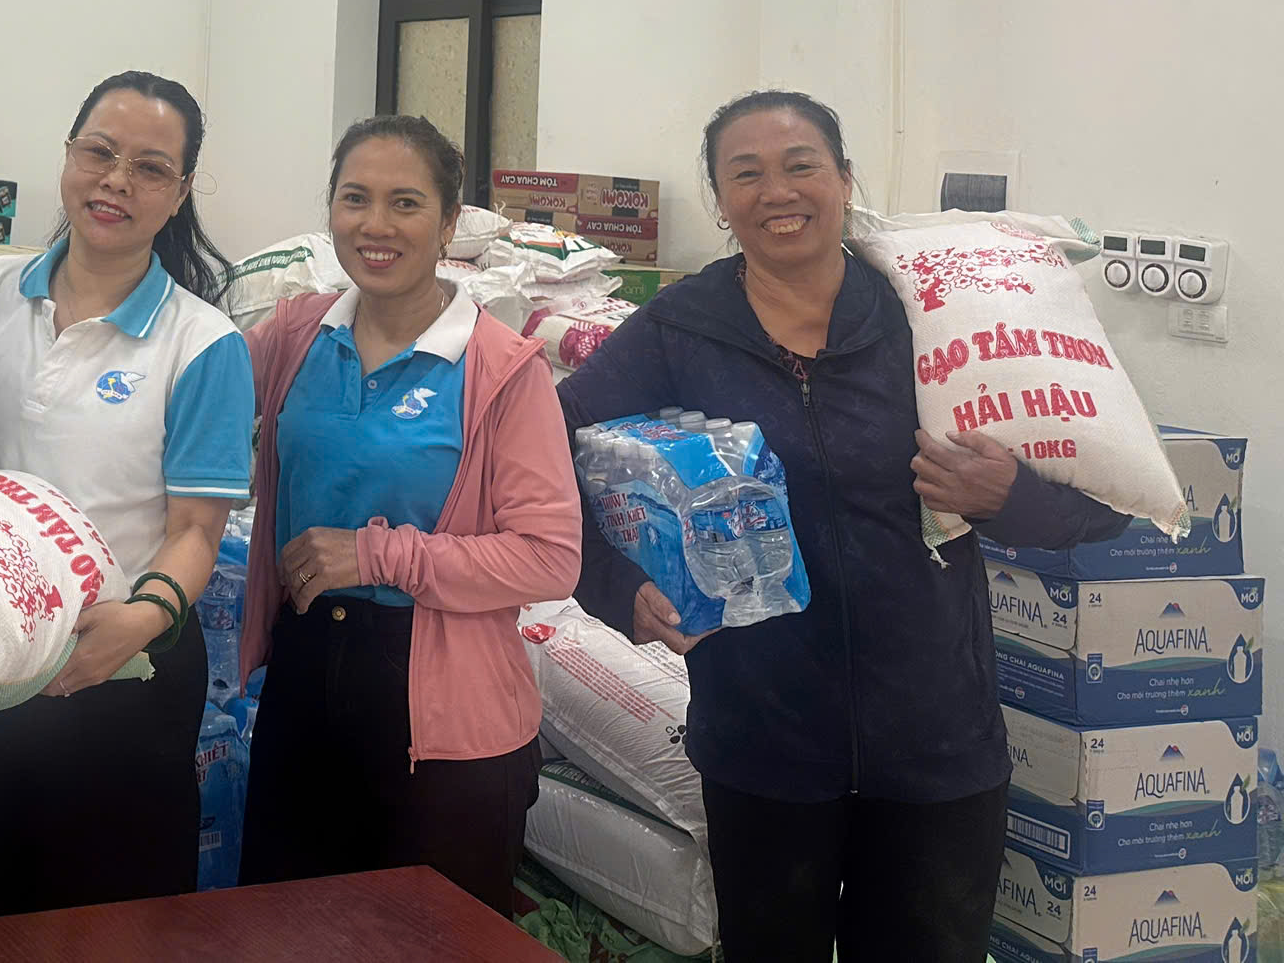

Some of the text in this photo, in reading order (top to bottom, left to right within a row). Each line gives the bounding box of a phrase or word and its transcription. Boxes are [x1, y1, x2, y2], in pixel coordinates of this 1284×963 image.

[500, 174, 558, 187] TÔM CHUA CAY
[530, 195, 566, 208] KOKOMI
[602, 188, 650, 210] KOKOMI
[586, 221, 643, 235] TÔM CHUA CAY
[916, 338, 969, 386] GẠO
[952, 382, 1098, 433] HẢI HẬU
[1021, 439, 1077, 460] 10KG
[1109, 548, 1123, 557] Cho
[1088, 592, 1102, 604] 24
[1052, 611, 1068, 625] 24
[1133, 625, 1209, 657] AQUAFINA
[1027, 662, 1065, 680] AQUAFINA
[1117, 692, 1131, 701] Cho
[1187, 677, 1226, 697] xanh
[1149, 677, 1166, 687] Chai
[1090, 738, 1105, 749] 24
[1133, 767, 1207, 801] AQUAFINA
[1149, 822, 1165, 832] Chai
[1118, 837, 1131, 846] Cho
[1083, 885, 1097, 897] 24
[1046, 900, 1062, 916] 24
[1128, 911, 1205, 948] AQUAFINA
